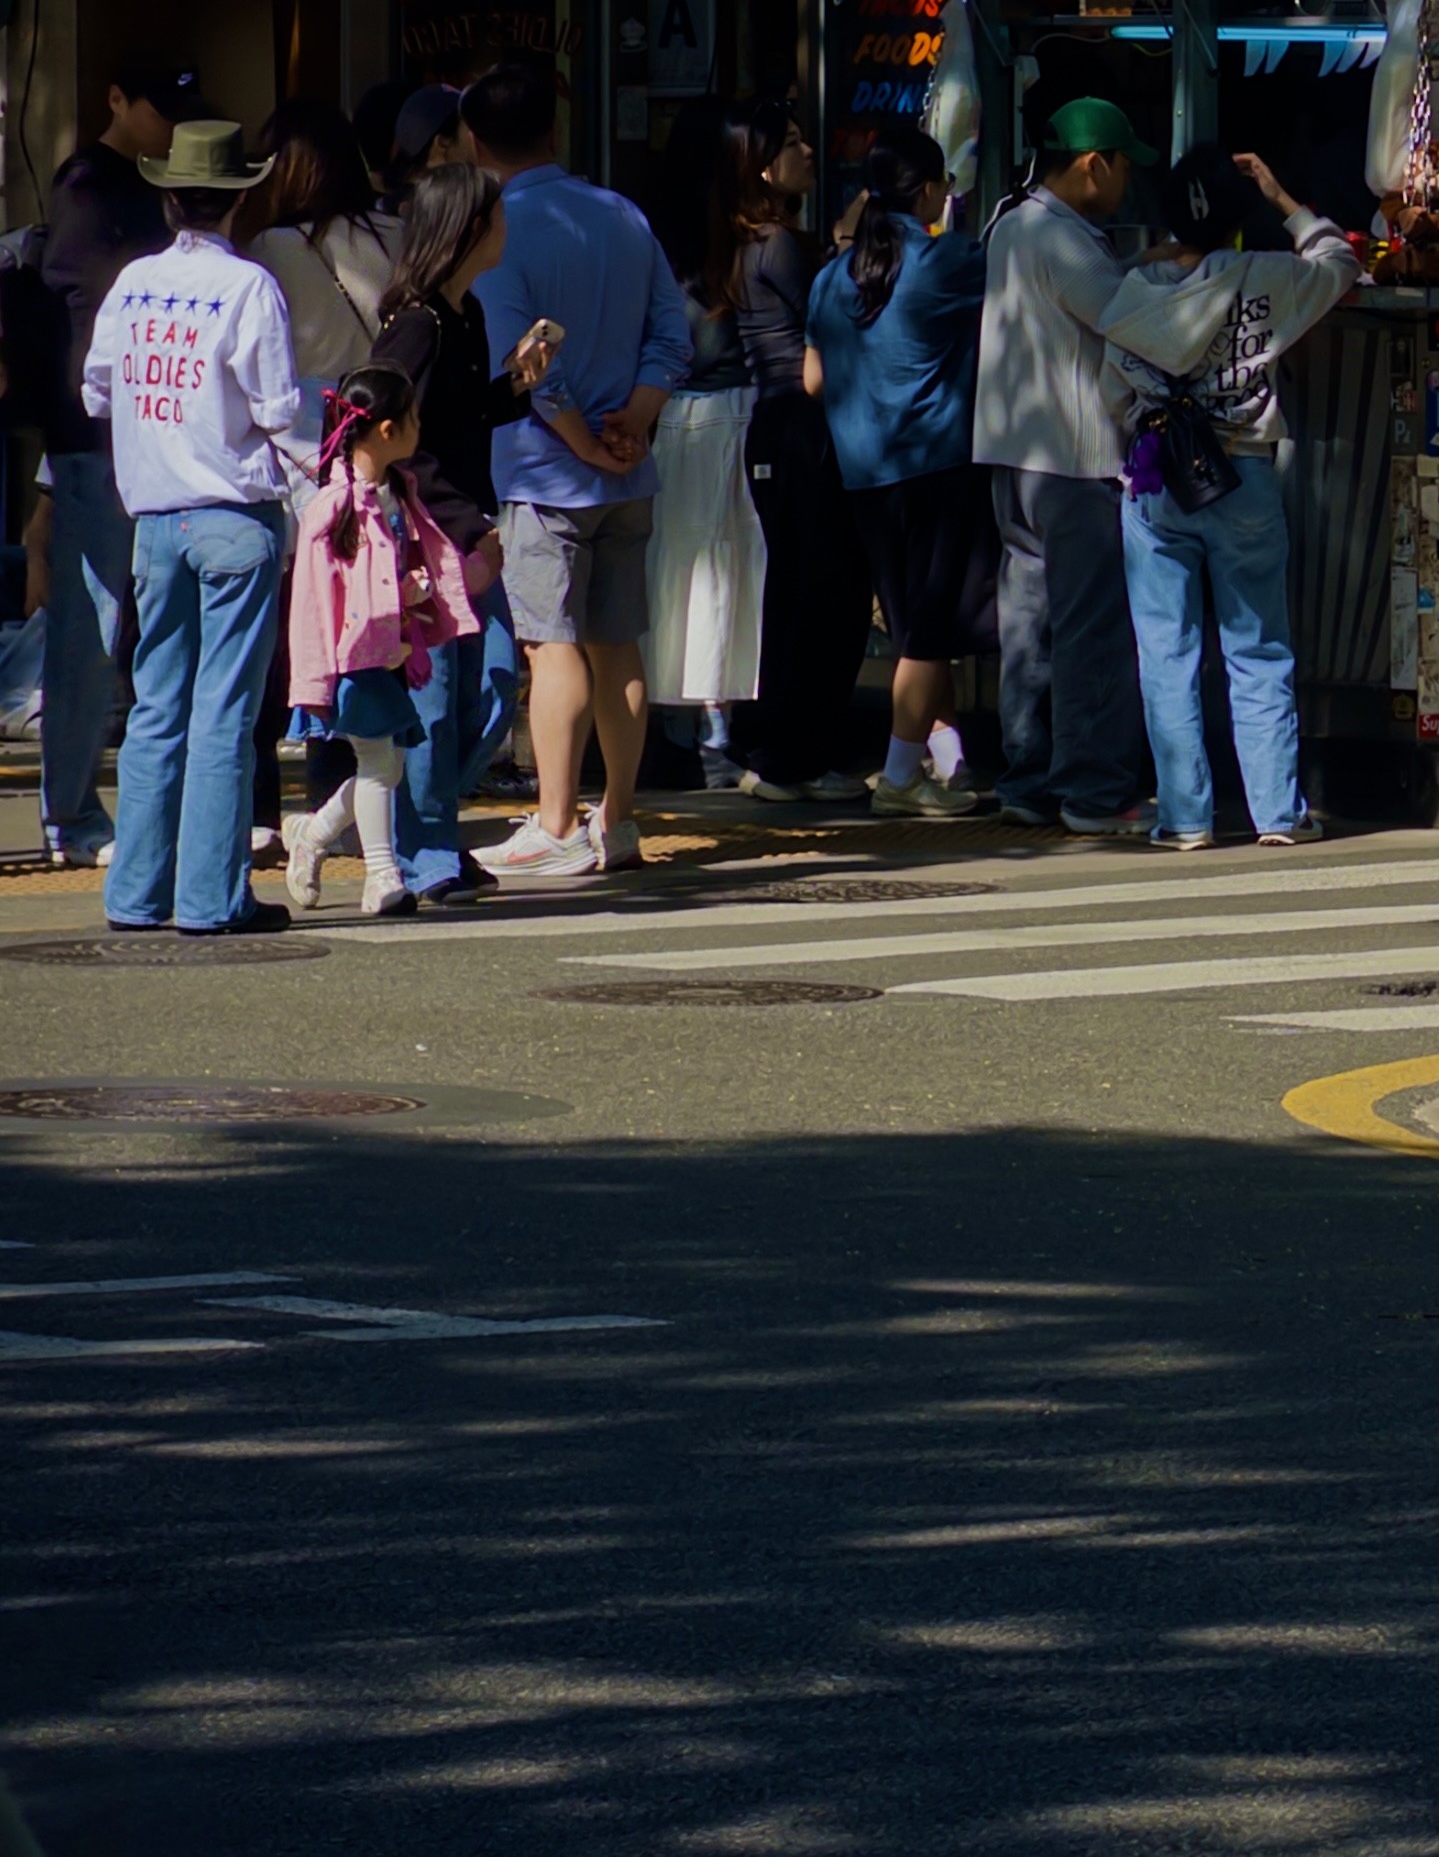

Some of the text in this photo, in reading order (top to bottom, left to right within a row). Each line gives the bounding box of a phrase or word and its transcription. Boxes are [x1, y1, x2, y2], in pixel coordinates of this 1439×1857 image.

[131, 318, 198, 349] TEAM
[1228, 323, 1274, 362] for
[123, 353, 206, 390] OLDIES
[135, 394, 183, 424] TACO
